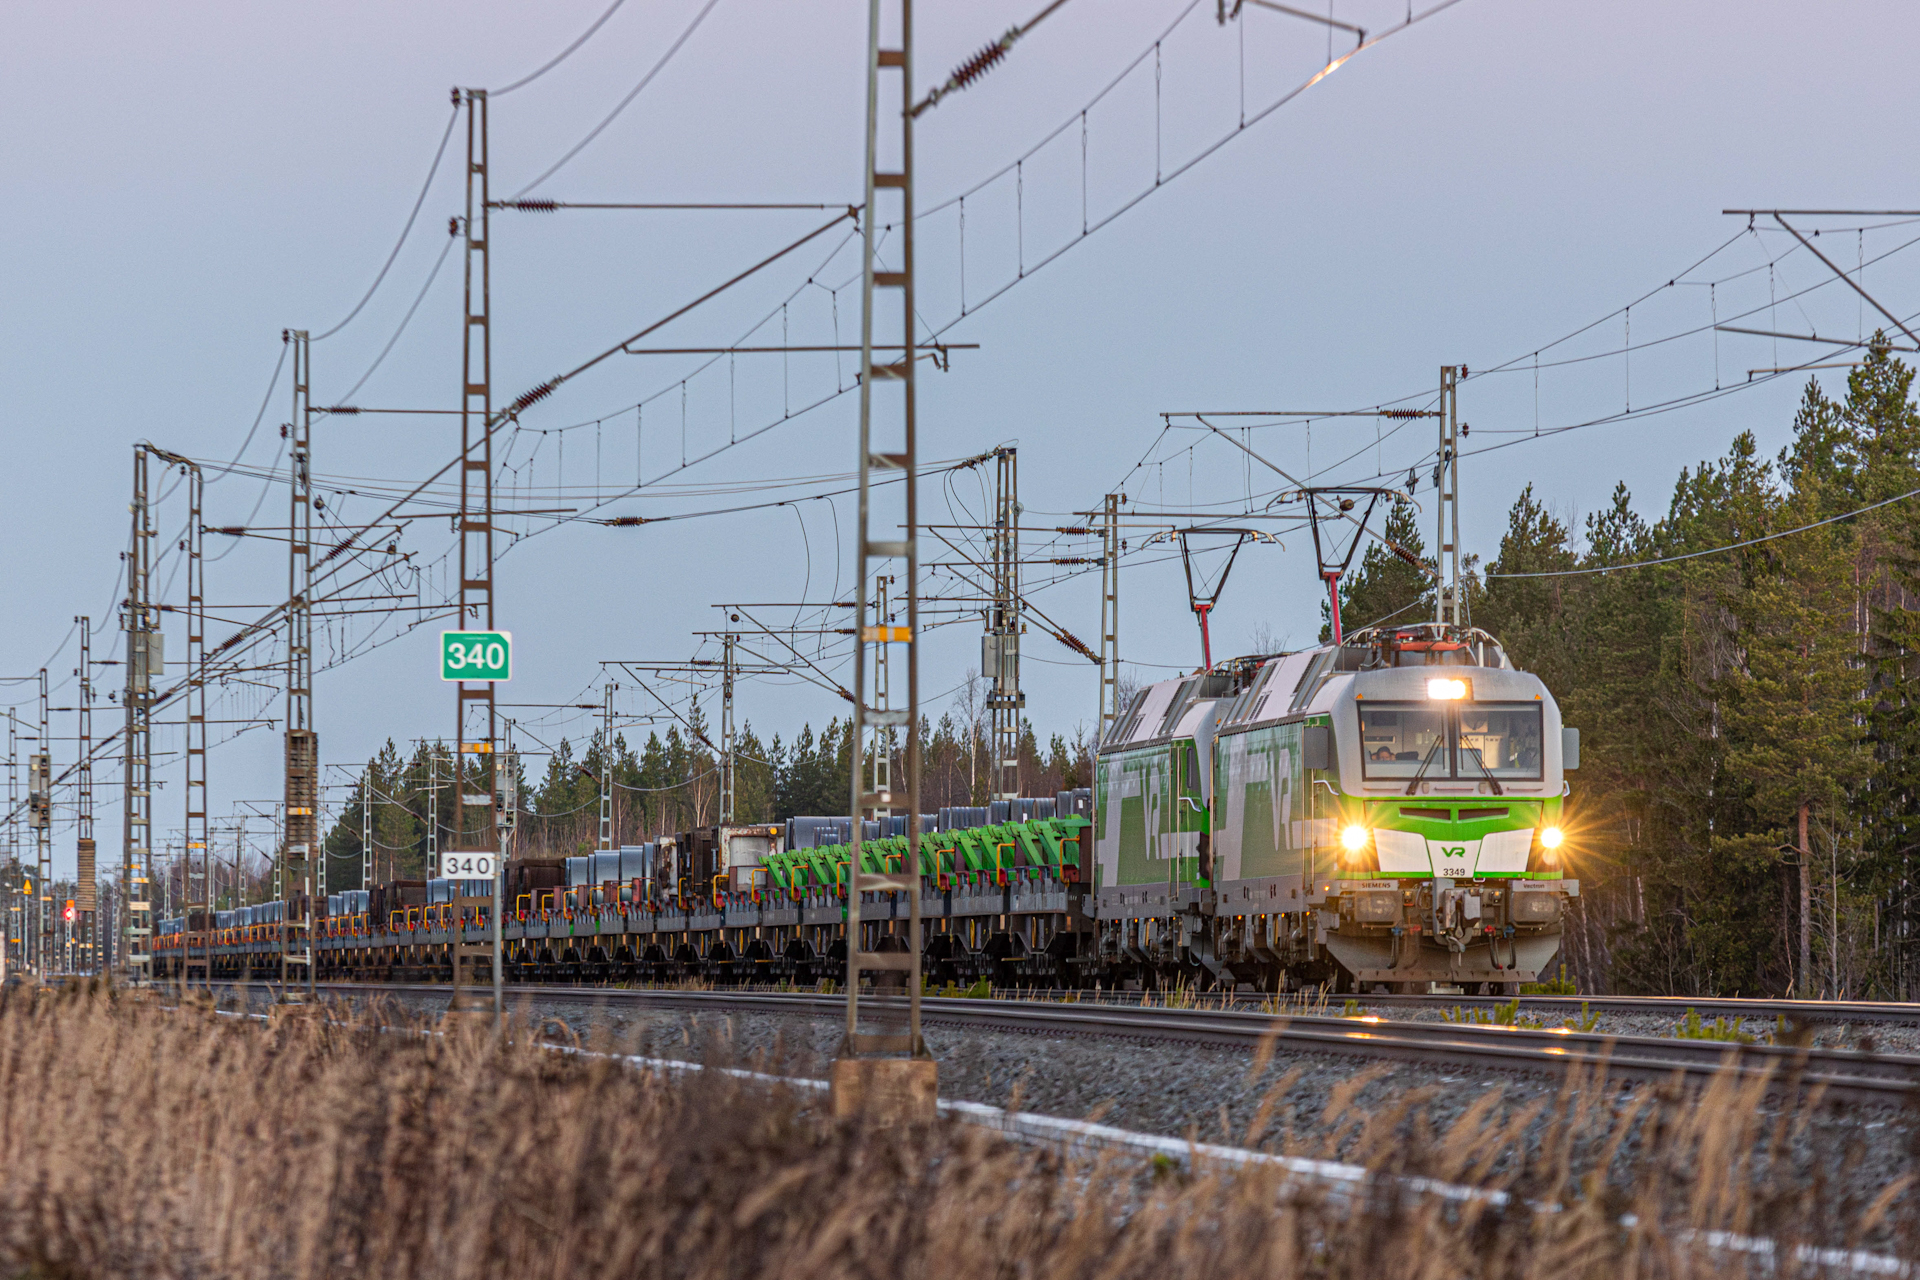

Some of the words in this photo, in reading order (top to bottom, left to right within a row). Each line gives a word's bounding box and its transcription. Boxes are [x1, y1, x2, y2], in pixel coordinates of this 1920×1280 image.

[447, 642, 505, 670] 340
[1269, 749, 1291, 851] VR
[1142, 766, 1161, 860] VR
[1441, 846, 1465, 858] VR
[446, 857, 489, 874] 340
[1443, 868, 1465, 876] 3349
